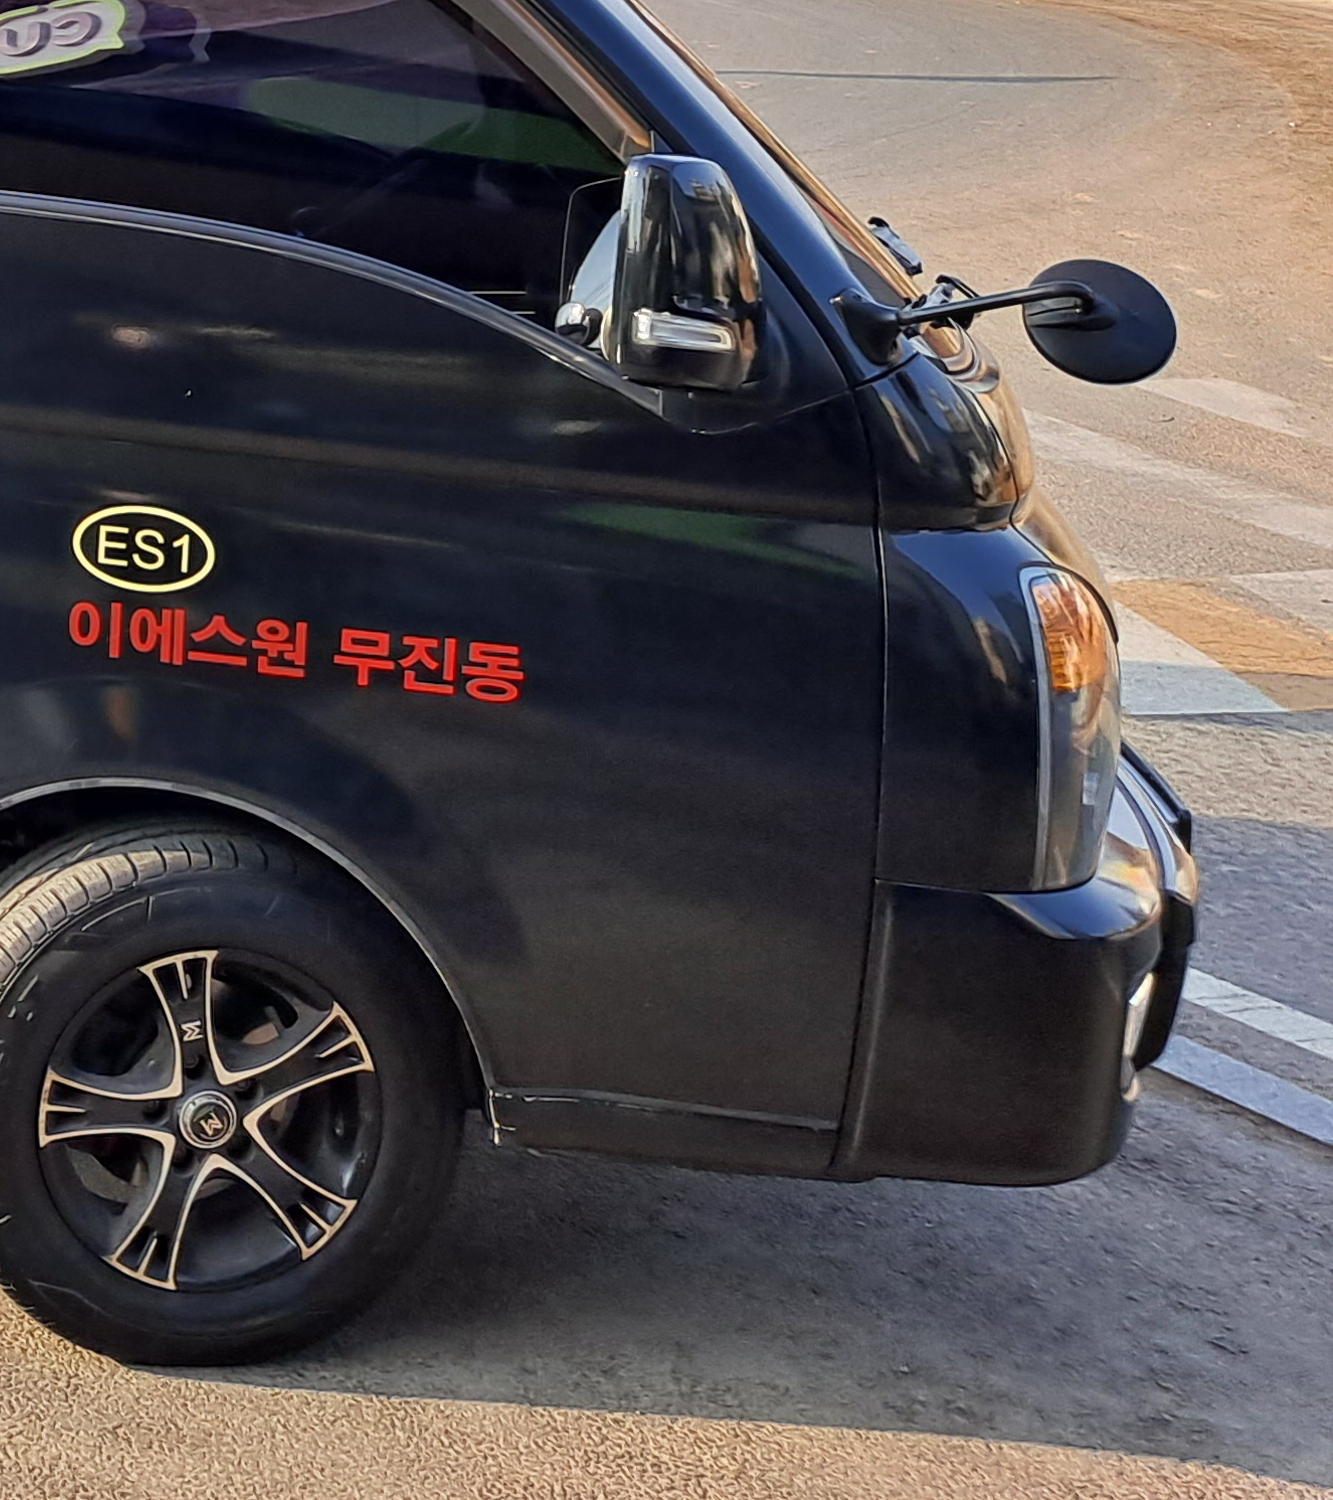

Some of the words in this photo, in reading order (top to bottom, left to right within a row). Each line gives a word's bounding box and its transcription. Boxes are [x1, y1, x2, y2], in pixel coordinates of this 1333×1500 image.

[96, 523, 191, 574] ES1
[68, 601, 309, 679] 이에스원
[333, 627, 526, 702] 무진동
